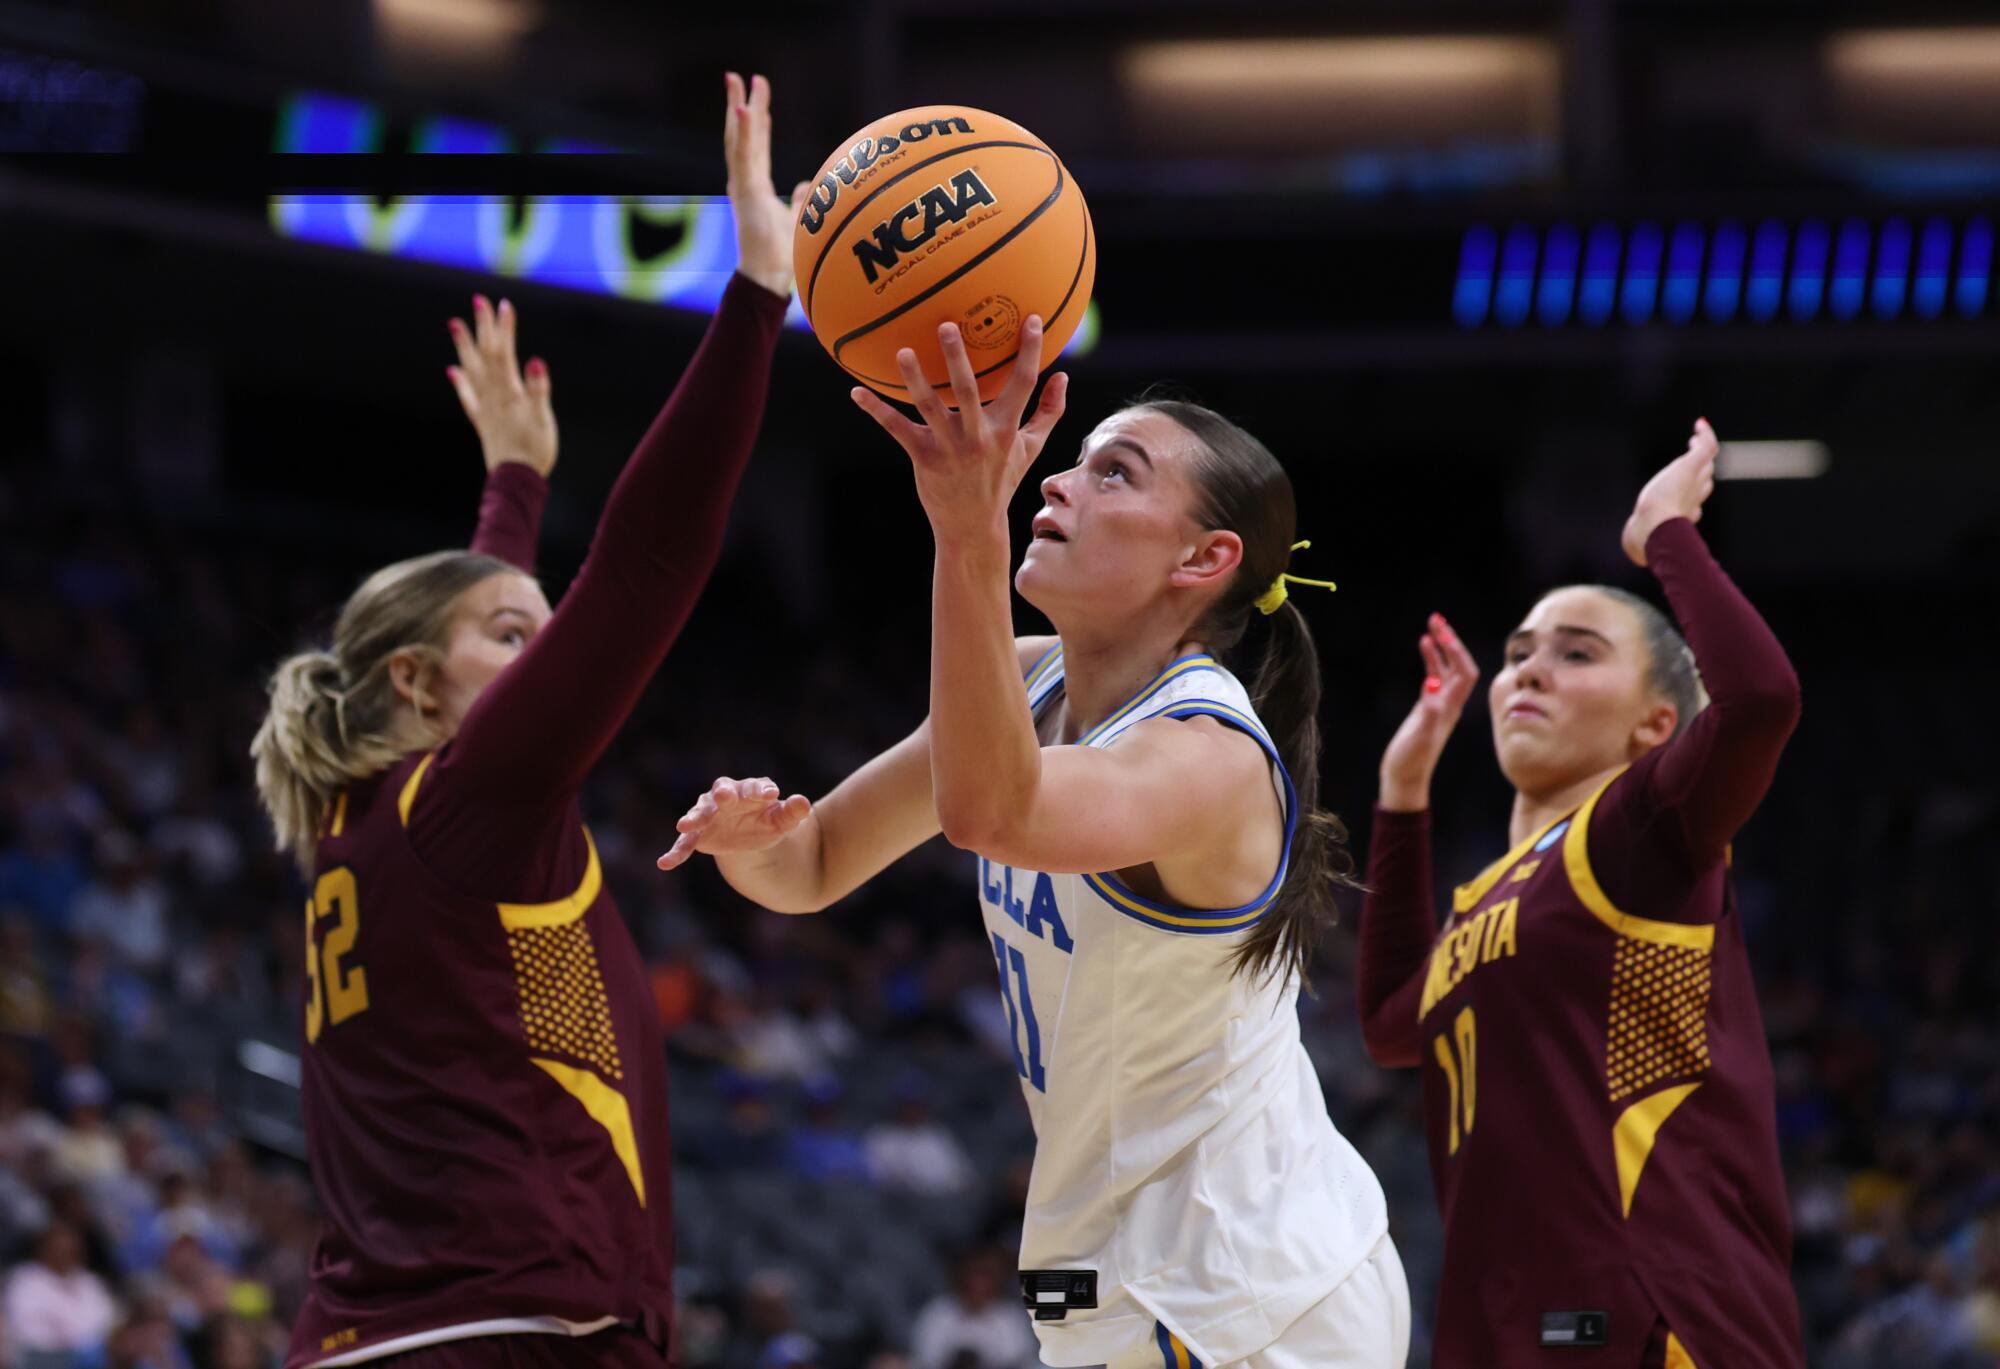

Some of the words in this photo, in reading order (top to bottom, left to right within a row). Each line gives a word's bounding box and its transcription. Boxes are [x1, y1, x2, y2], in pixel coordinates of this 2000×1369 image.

[800, 116, 975, 235] Wilson
[852, 168, 877, 190] EVO
[880, 150, 907, 168] NXT
[852, 168, 998, 285] NCAA
[875, 255, 926, 295] OFFICIAL
[926, 226, 966, 254] GAME
[966, 208, 1002, 229] BALL
[978, 856, 1074, 955] CLA
[991, 931, 1046, 1094] 11
[1434, 1005, 1476, 1155] 10
[1584, 1320, 1596, 1336] L
